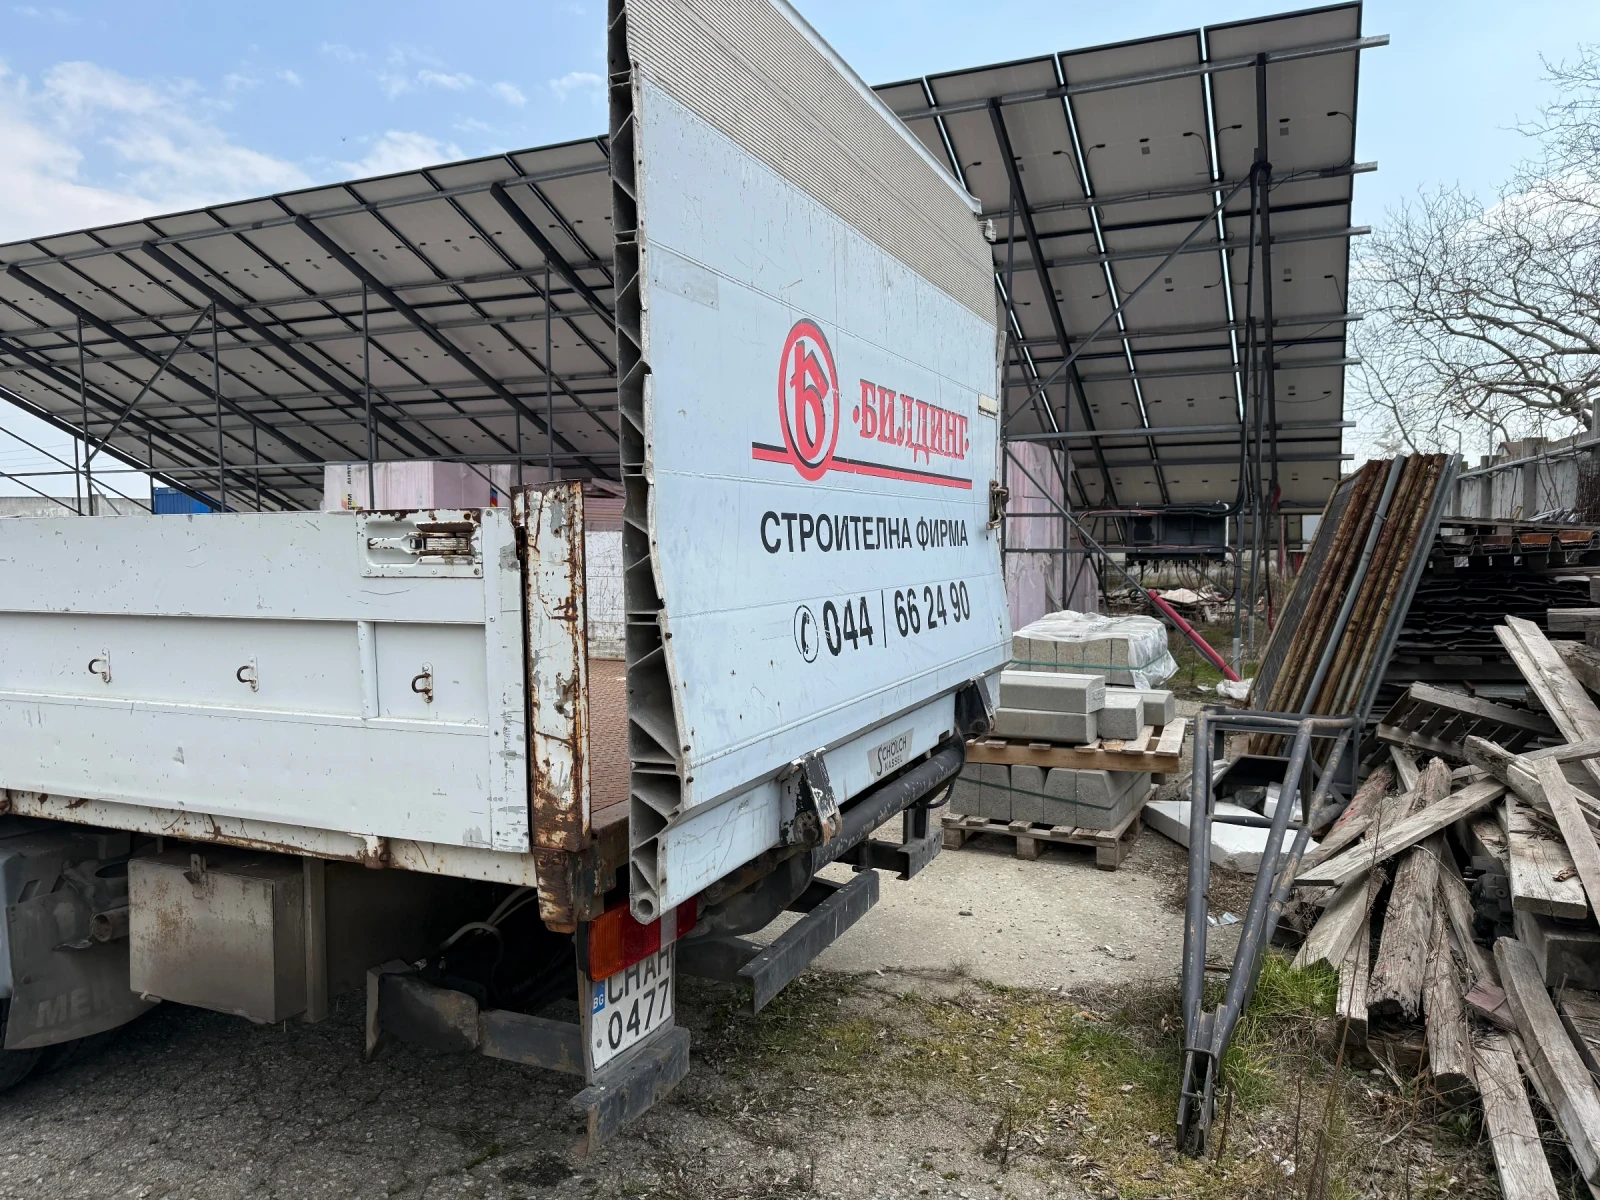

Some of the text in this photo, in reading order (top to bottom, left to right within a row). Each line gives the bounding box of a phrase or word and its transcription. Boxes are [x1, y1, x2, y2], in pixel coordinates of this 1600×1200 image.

[760, 511, 969, 554] СТРОИТЕЛНА ФИРМА
[823, 596, 873, 656] 044
[894, 588, 921, 638] 66
[923, 585, 948, 630] 24
[949, 580, 971, 623] 90
[593, 993, 604, 1010] BG
[608, 977, 669, 1050] 0477
